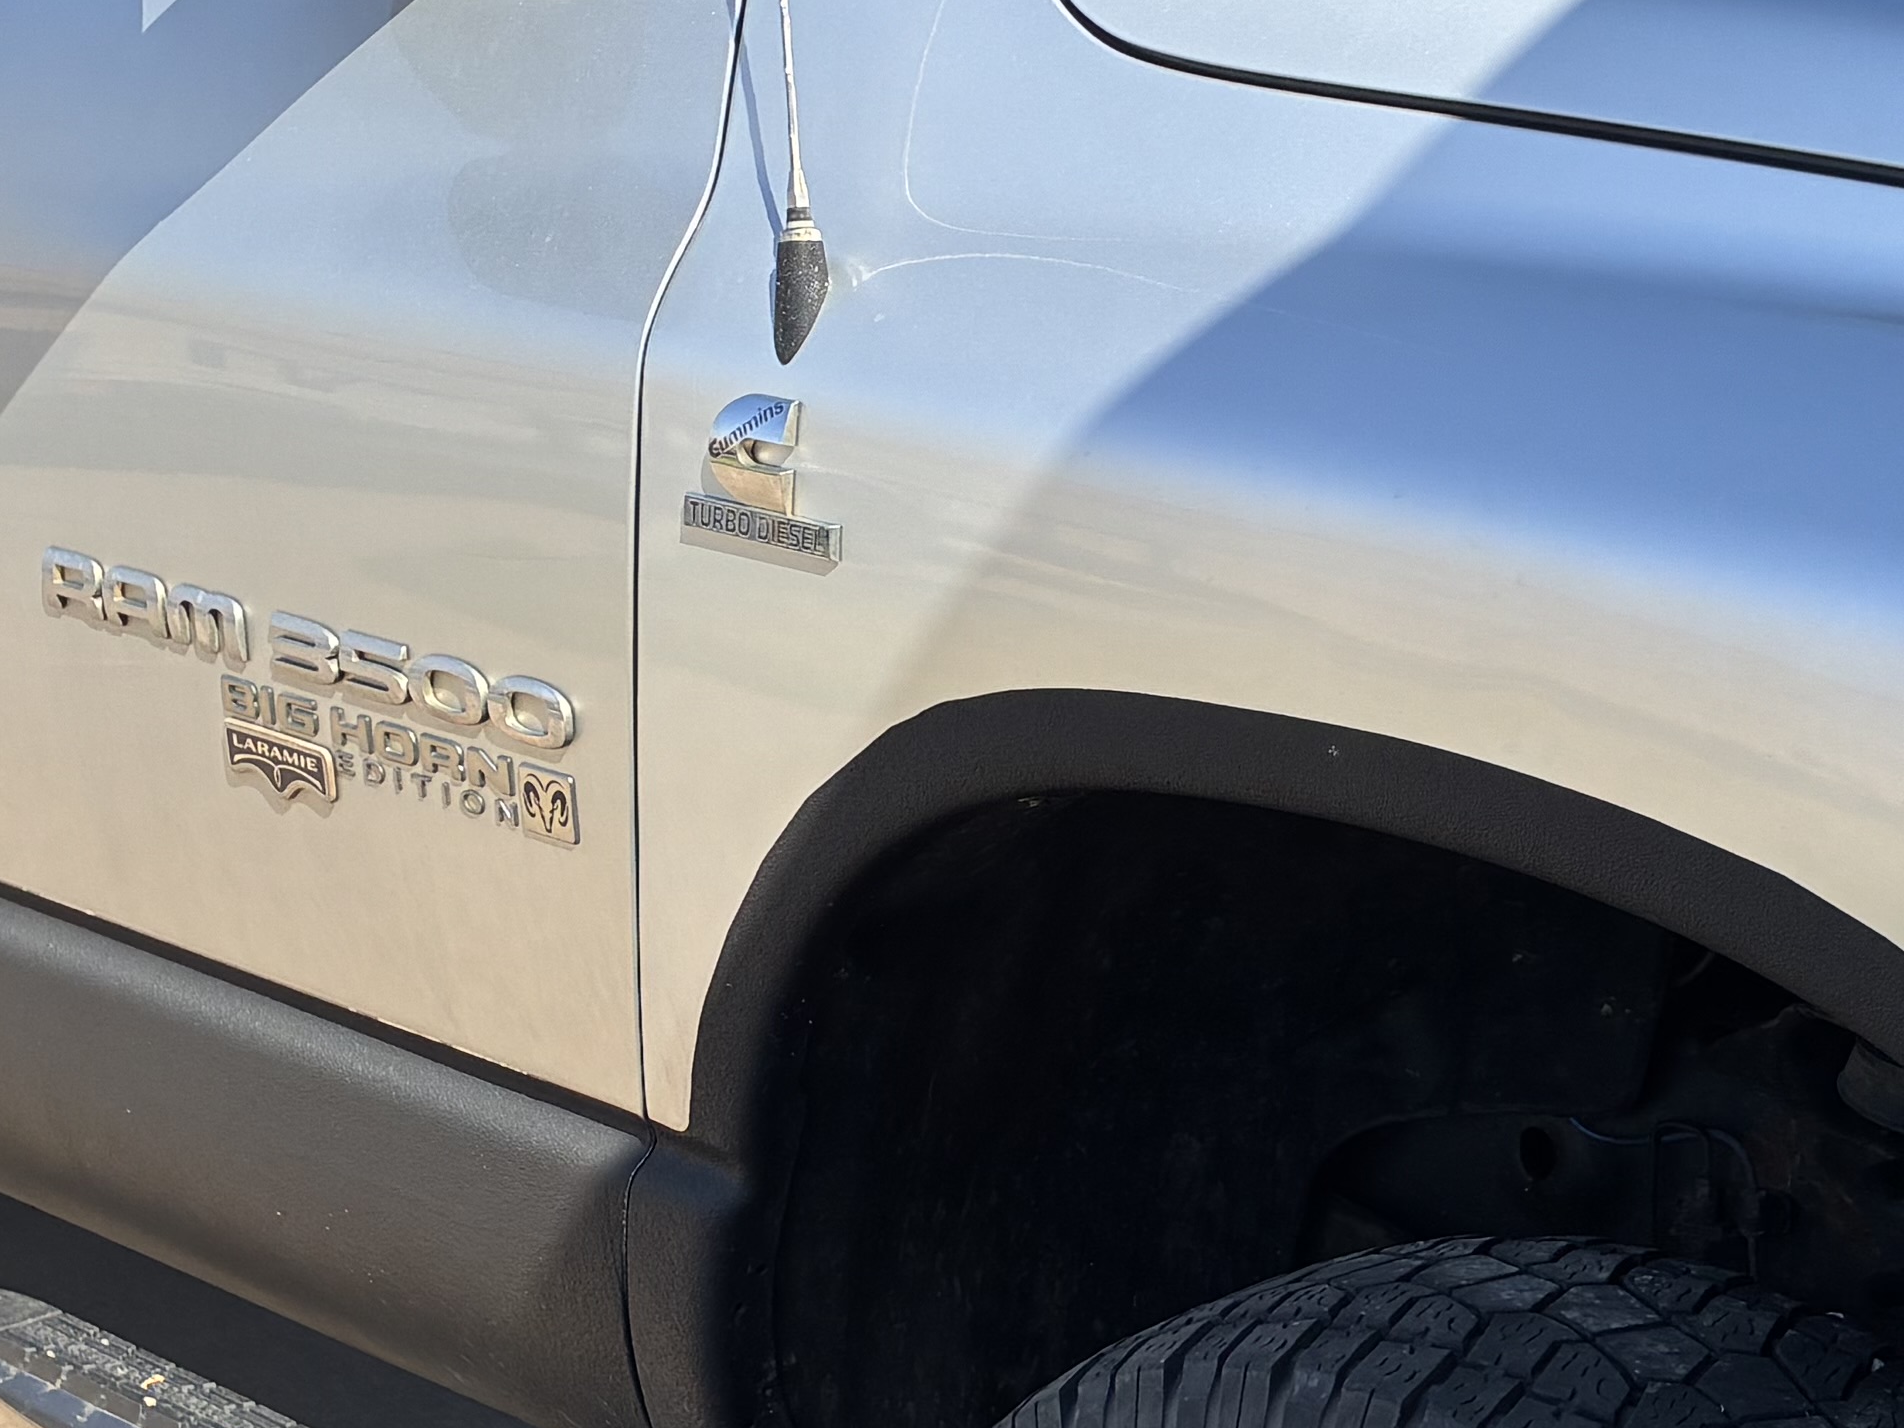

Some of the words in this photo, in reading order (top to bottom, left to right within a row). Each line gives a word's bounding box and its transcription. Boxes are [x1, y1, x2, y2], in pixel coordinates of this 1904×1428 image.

[708, 400, 785, 458] Cummins
[689, 499, 751, 538] TURBO
[755, 517, 827, 554] DIESEL
[41, 545, 250, 663] RAM
[268, 609, 576, 751] 3500
[220, 673, 321, 738] BIG
[329, 704, 516, 798] HORN
[231, 729, 320, 775] LARAMIE
[337, 748, 521, 828] EDITION
